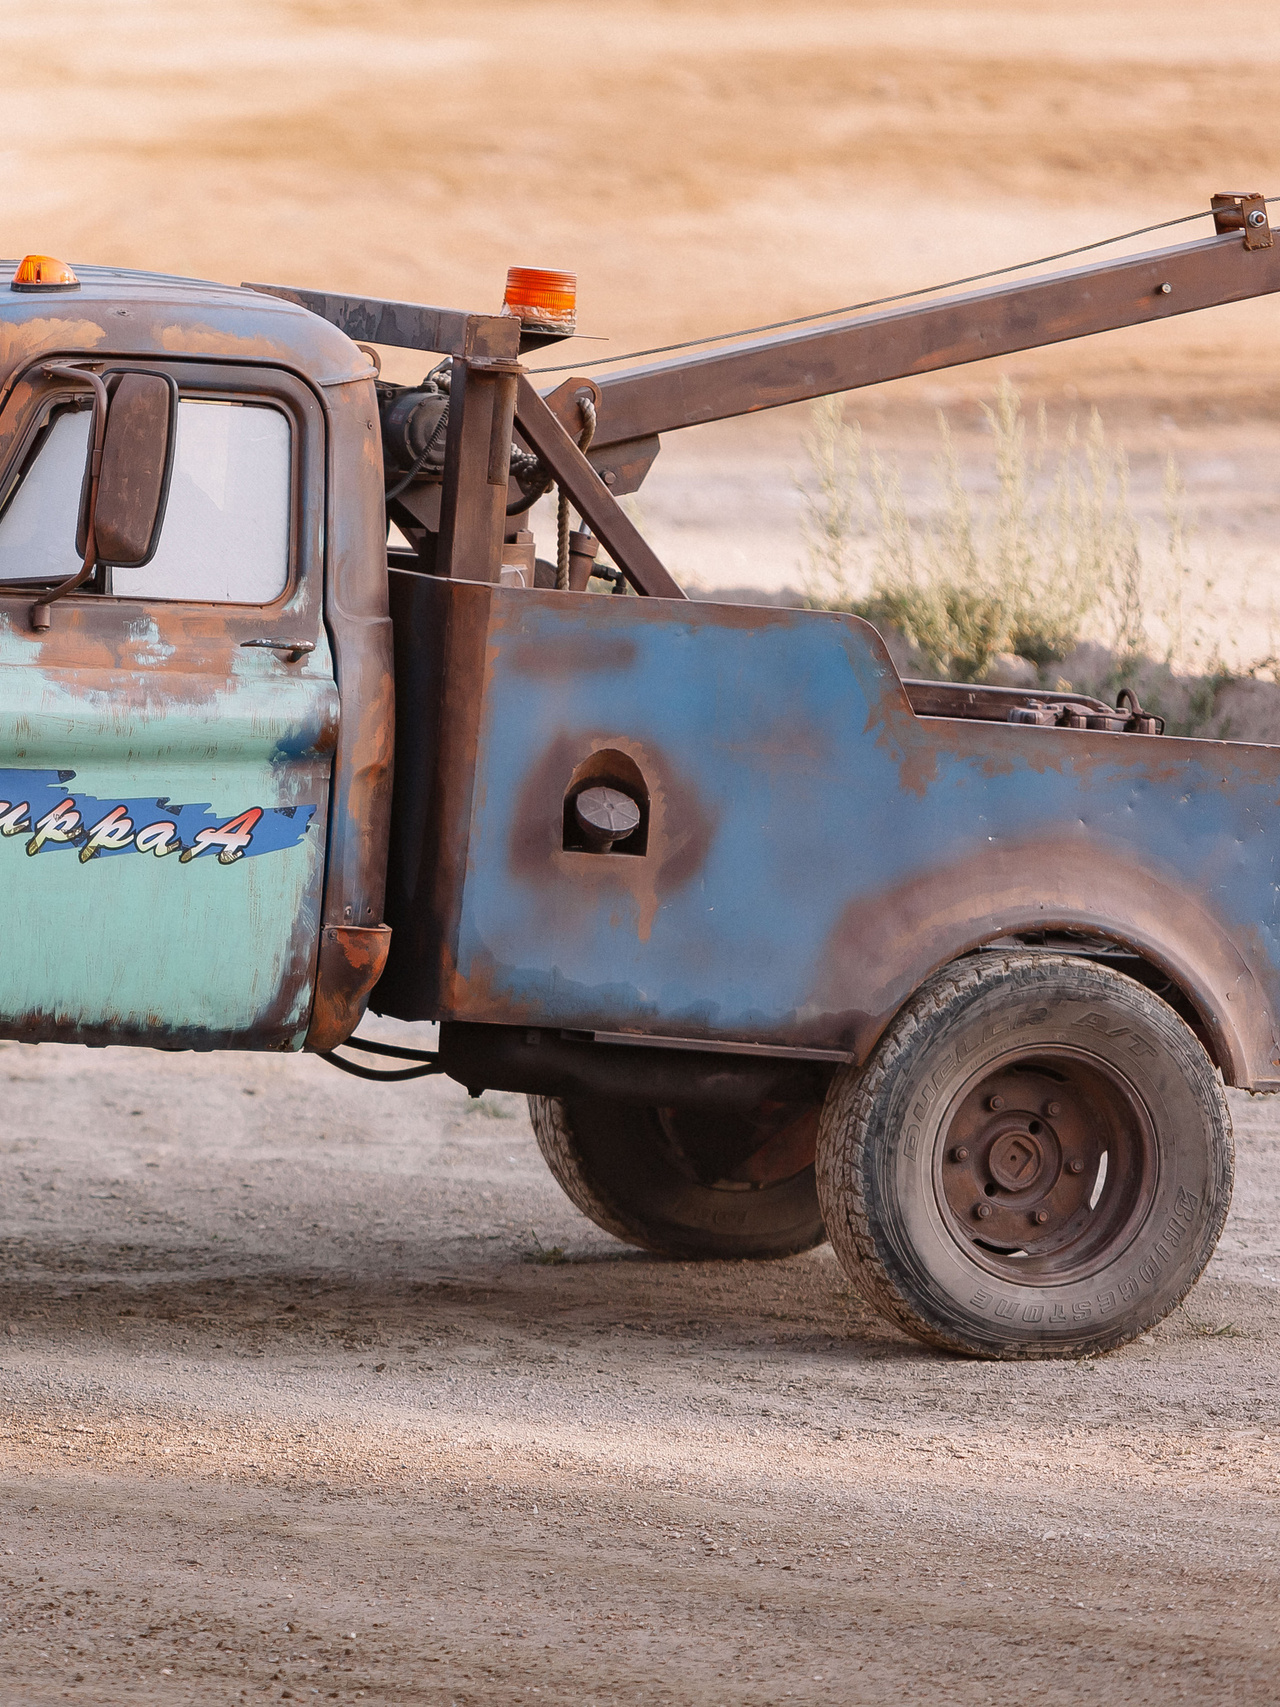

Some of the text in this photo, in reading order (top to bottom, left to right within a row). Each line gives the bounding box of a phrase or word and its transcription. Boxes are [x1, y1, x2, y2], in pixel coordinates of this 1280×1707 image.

[179, 807, 263, 865] A
[903, 1007, 1159, 1162] DUELER A/T
[970, 1185, 1199, 1323] BRIDGESTONE
